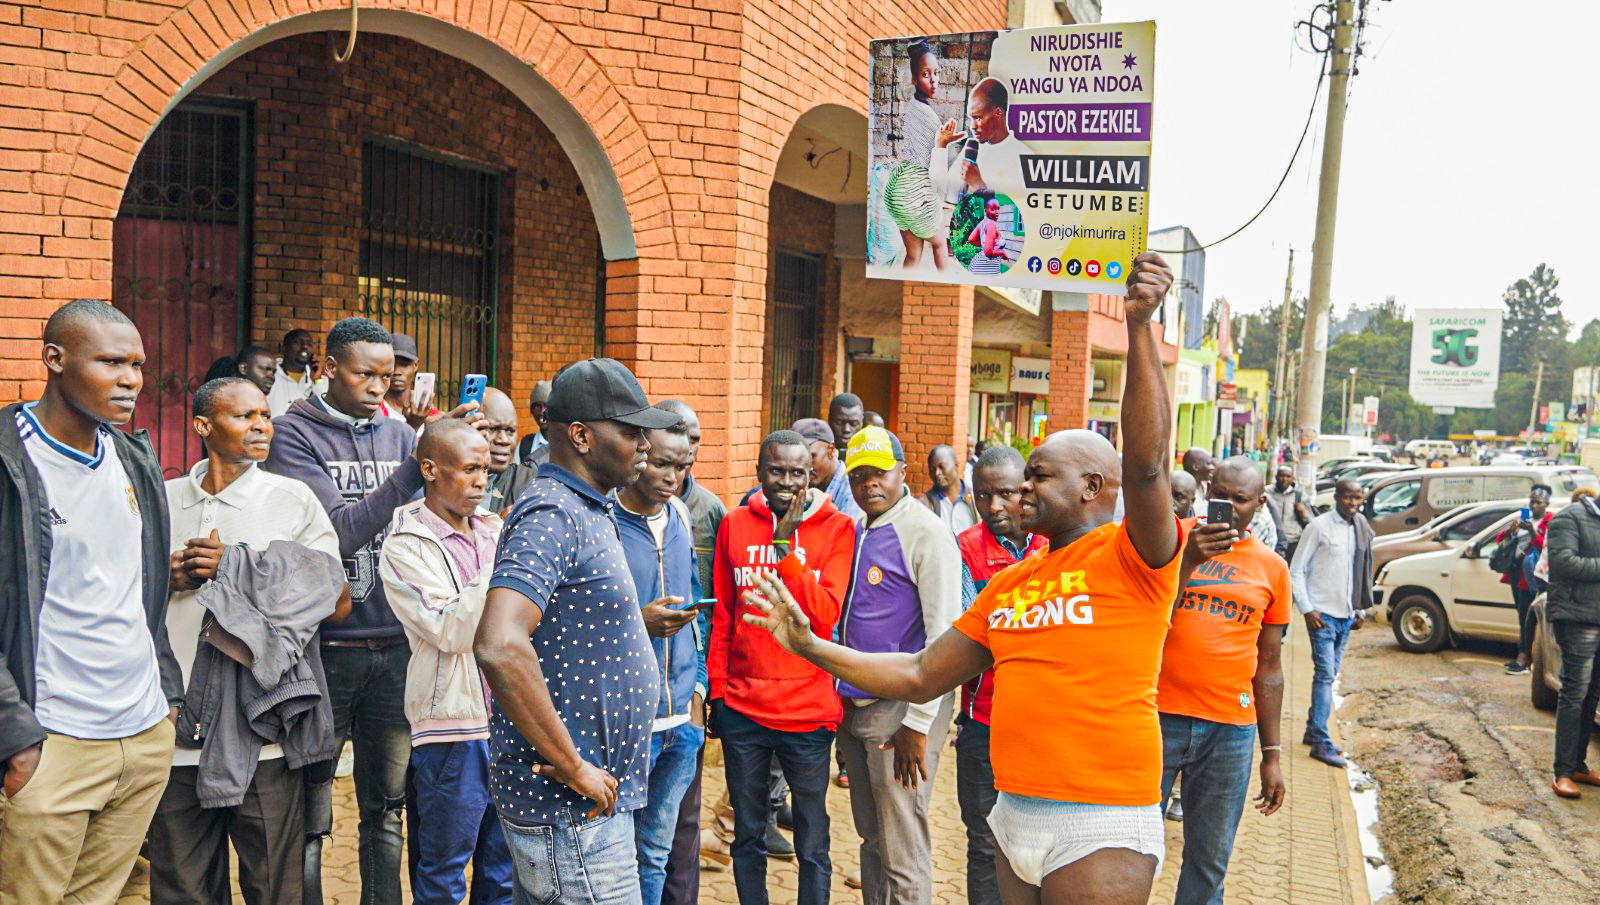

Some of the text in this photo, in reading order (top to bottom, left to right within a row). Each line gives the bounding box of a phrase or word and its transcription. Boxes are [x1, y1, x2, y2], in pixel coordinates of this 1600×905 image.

[1030, 31, 1123, 52] NIRUDISHIE
[1049, 55, 1102, 72] NYOTA
[1010, 75, 1143, 95] YANGU YA NDOA
[1018, 109, 1142, 134] PASTOR EZEKIEL
[1027, 159, 1141, 184] WILLIAM
[1027, 192, 1138, 212] GETUMBE
[1039, 223, 1126, 241] @njokimurira
[1429, 317, 1486, 326] SAFARICOM
[1431, 328, 1479, 367] 5G
[1019, 369, 1042, 380] BAUS
[1209, 595, 1238, 619] DO
[1237, 604, 1256, 625] IT
